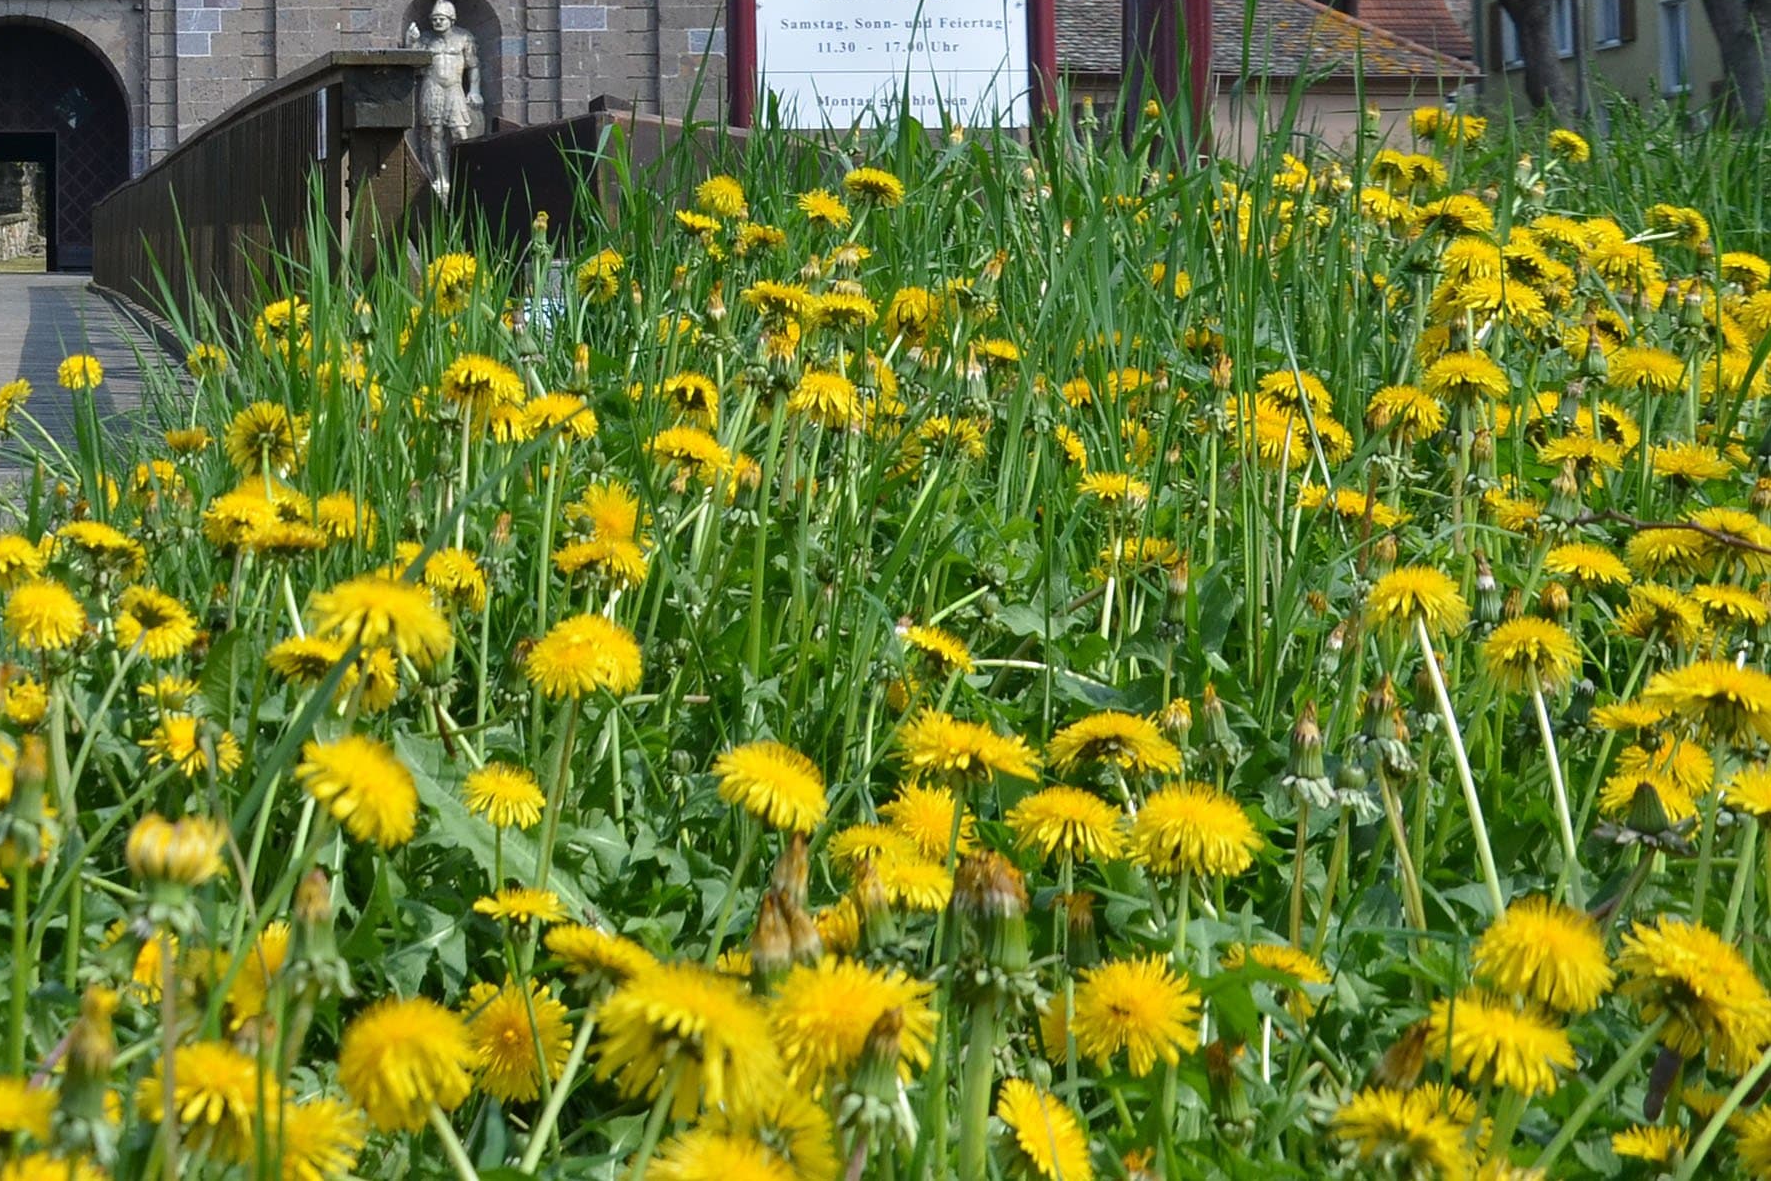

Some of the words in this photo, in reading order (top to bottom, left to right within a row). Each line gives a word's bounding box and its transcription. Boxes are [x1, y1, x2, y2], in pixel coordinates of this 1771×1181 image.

[854, 18, 899, 29] Sonn-
[939, 17, 1003, 29] Feiertag
[818, 42, 856, 53] 11.30
[931, 42, 959, 52] Uhr
